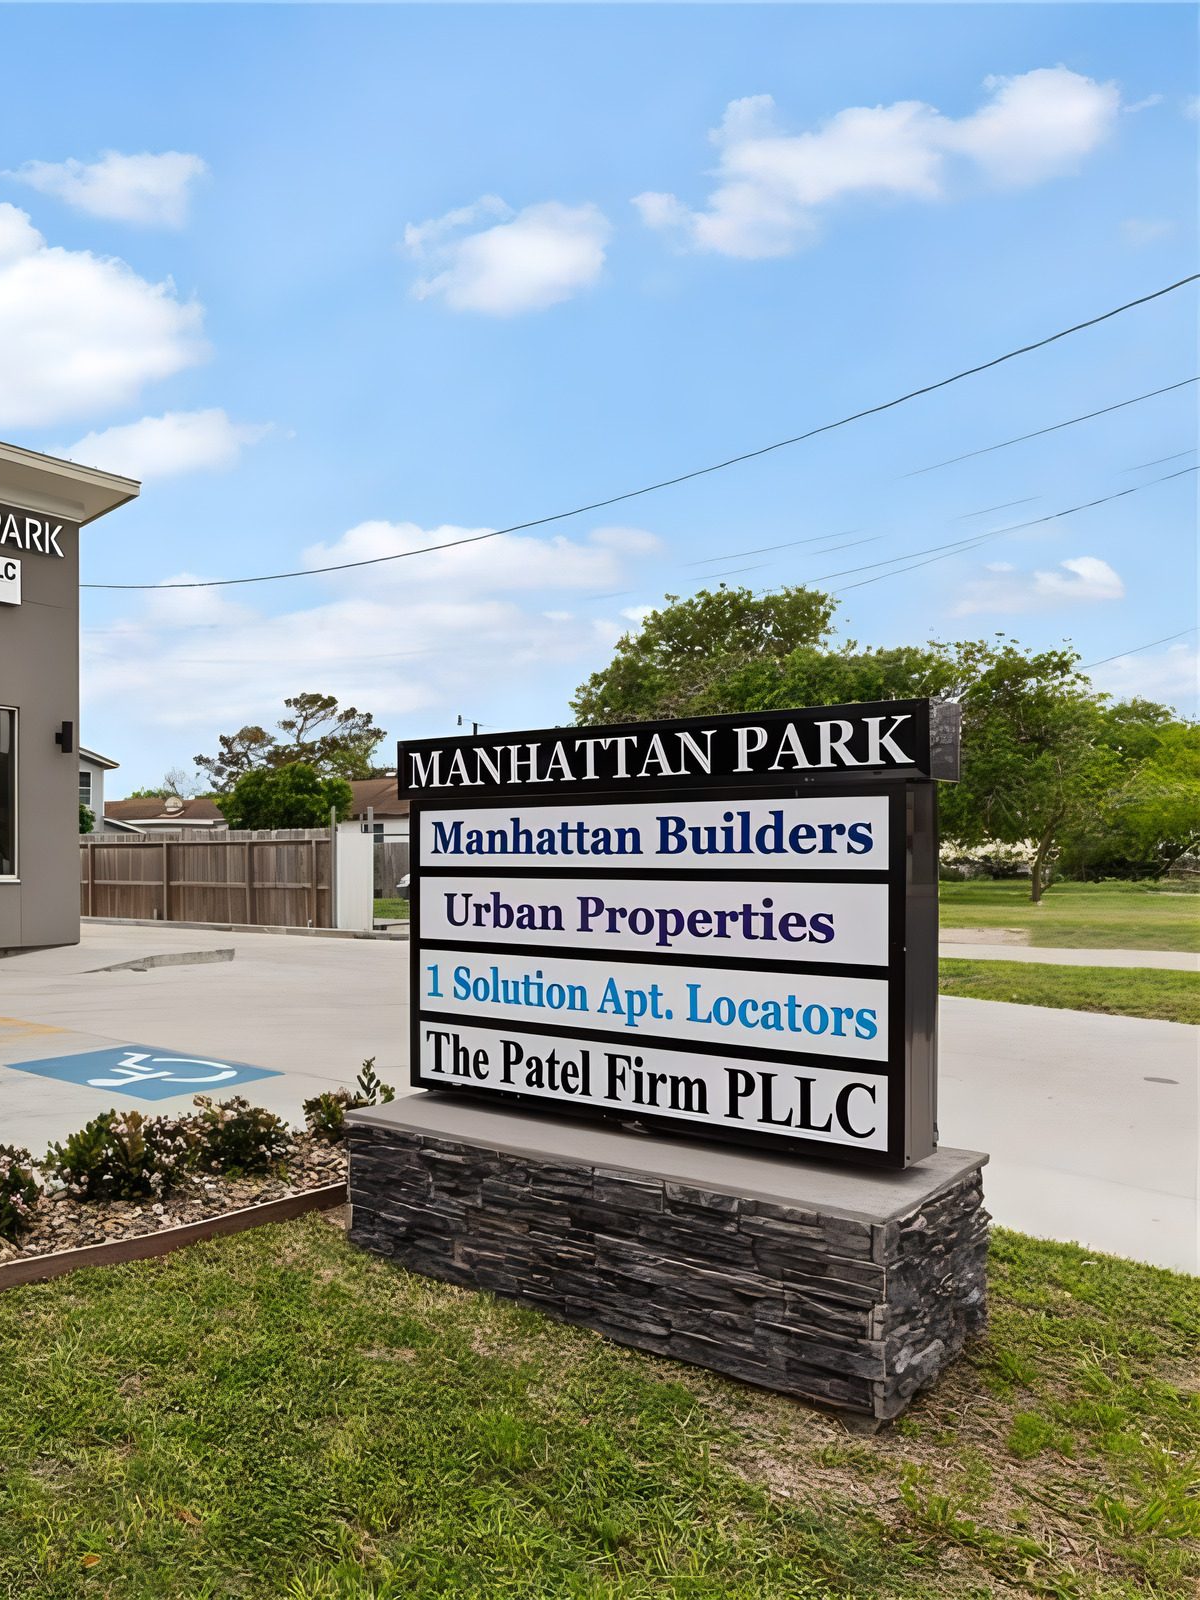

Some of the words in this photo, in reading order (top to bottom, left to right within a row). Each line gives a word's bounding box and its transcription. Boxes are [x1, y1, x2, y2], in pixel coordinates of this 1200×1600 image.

[408, 729, 718, 788] MANHATTAN
[733, 714, 915, 772] PARK
[431, 817, 642, 855] Manhattan
[655, 810, 874, 855] Builders
[444, 891, 563, 931] Urban
[576, 896, 836, 946] Properties
[426, 964, 441, 998] 1
[452, 965, 590, 1014] Solution
[597, 977, 674, 1027] Apt.
[686, 983, 878, 1041] Locators
[426, 1030, 490, 1080] The
[500, 1039, 591, 1096] Patel
[603, 1052, 709, 1115] Firm
[724, 1067, 877, 1139] PLLC
